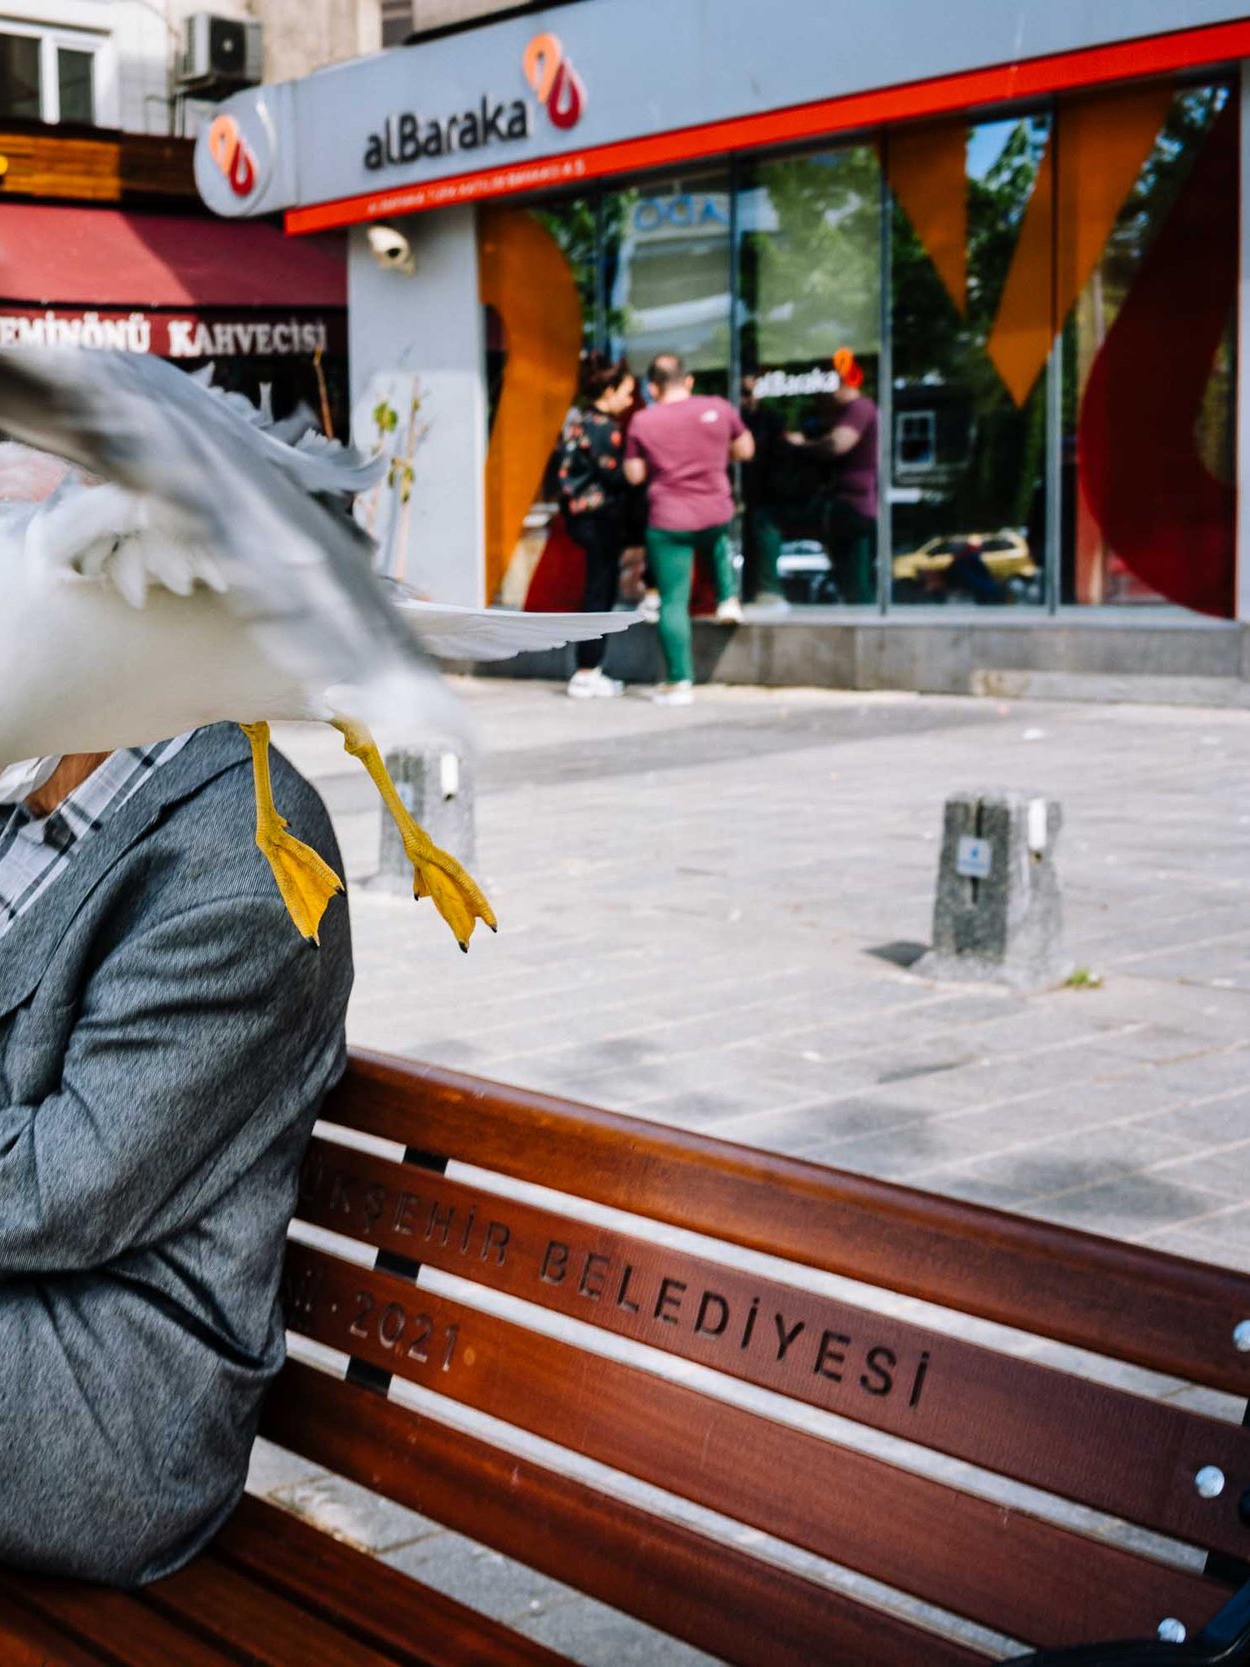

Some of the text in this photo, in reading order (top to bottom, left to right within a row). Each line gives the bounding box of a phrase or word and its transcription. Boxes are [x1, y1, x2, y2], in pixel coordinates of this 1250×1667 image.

[364, 93, 528, 171] alBaraka
[167, 315, 327, 358] KAHVECİSİ
[348, 1290, 461, 1373] 2021
[539, 1239, 931, 1408] BELEDİYESİ
